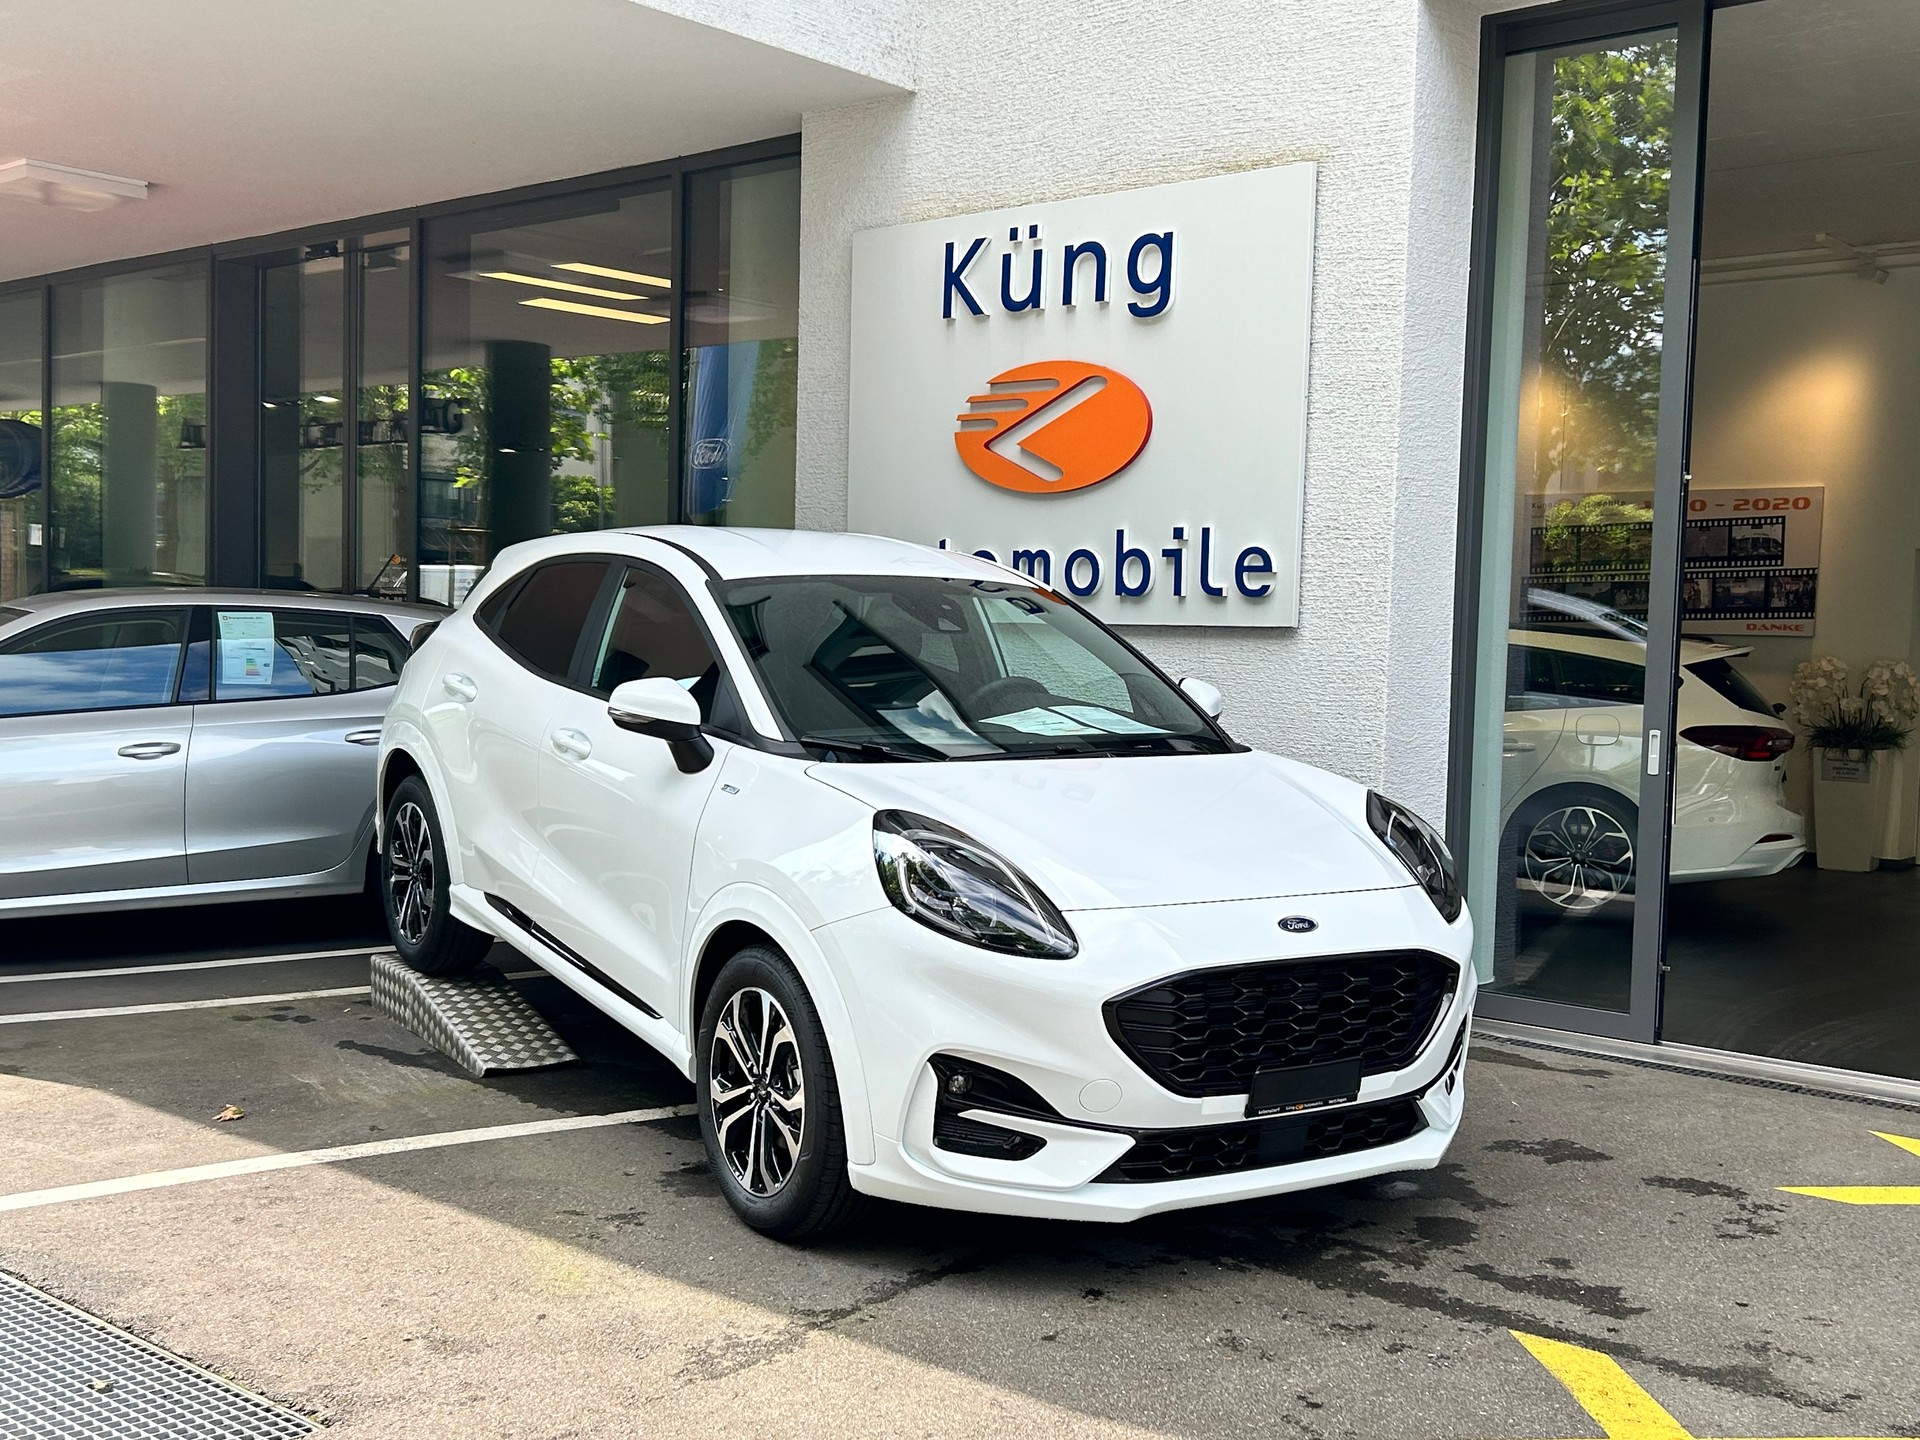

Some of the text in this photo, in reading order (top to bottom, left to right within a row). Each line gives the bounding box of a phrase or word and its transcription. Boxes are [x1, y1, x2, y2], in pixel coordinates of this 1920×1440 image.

[943, 224, 1178, 320] Küng
[1733, 496, 1811, 511] 2020
[1746, 623, 1805, 633] DANKE
[1287, 920, 1310, 930] Ford
